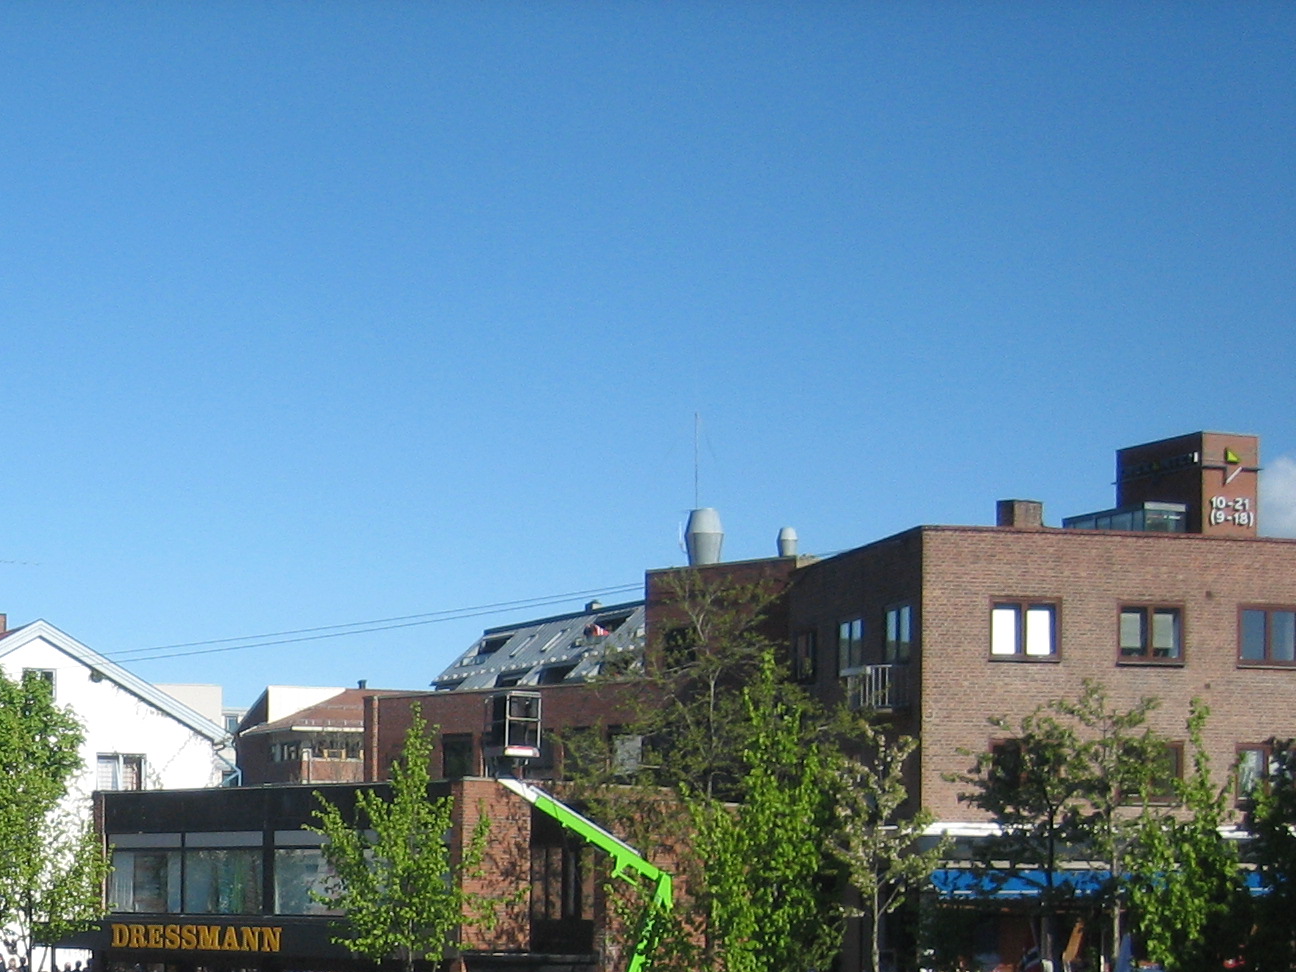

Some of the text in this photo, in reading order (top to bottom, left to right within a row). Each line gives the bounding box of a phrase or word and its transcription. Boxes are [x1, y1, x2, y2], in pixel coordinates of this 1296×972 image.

[1211, 496, 1250, 511] 10-21
[1210, 509, 1254, 527] (9-18)
[111, 923, 282, 952] DRESSMANN
